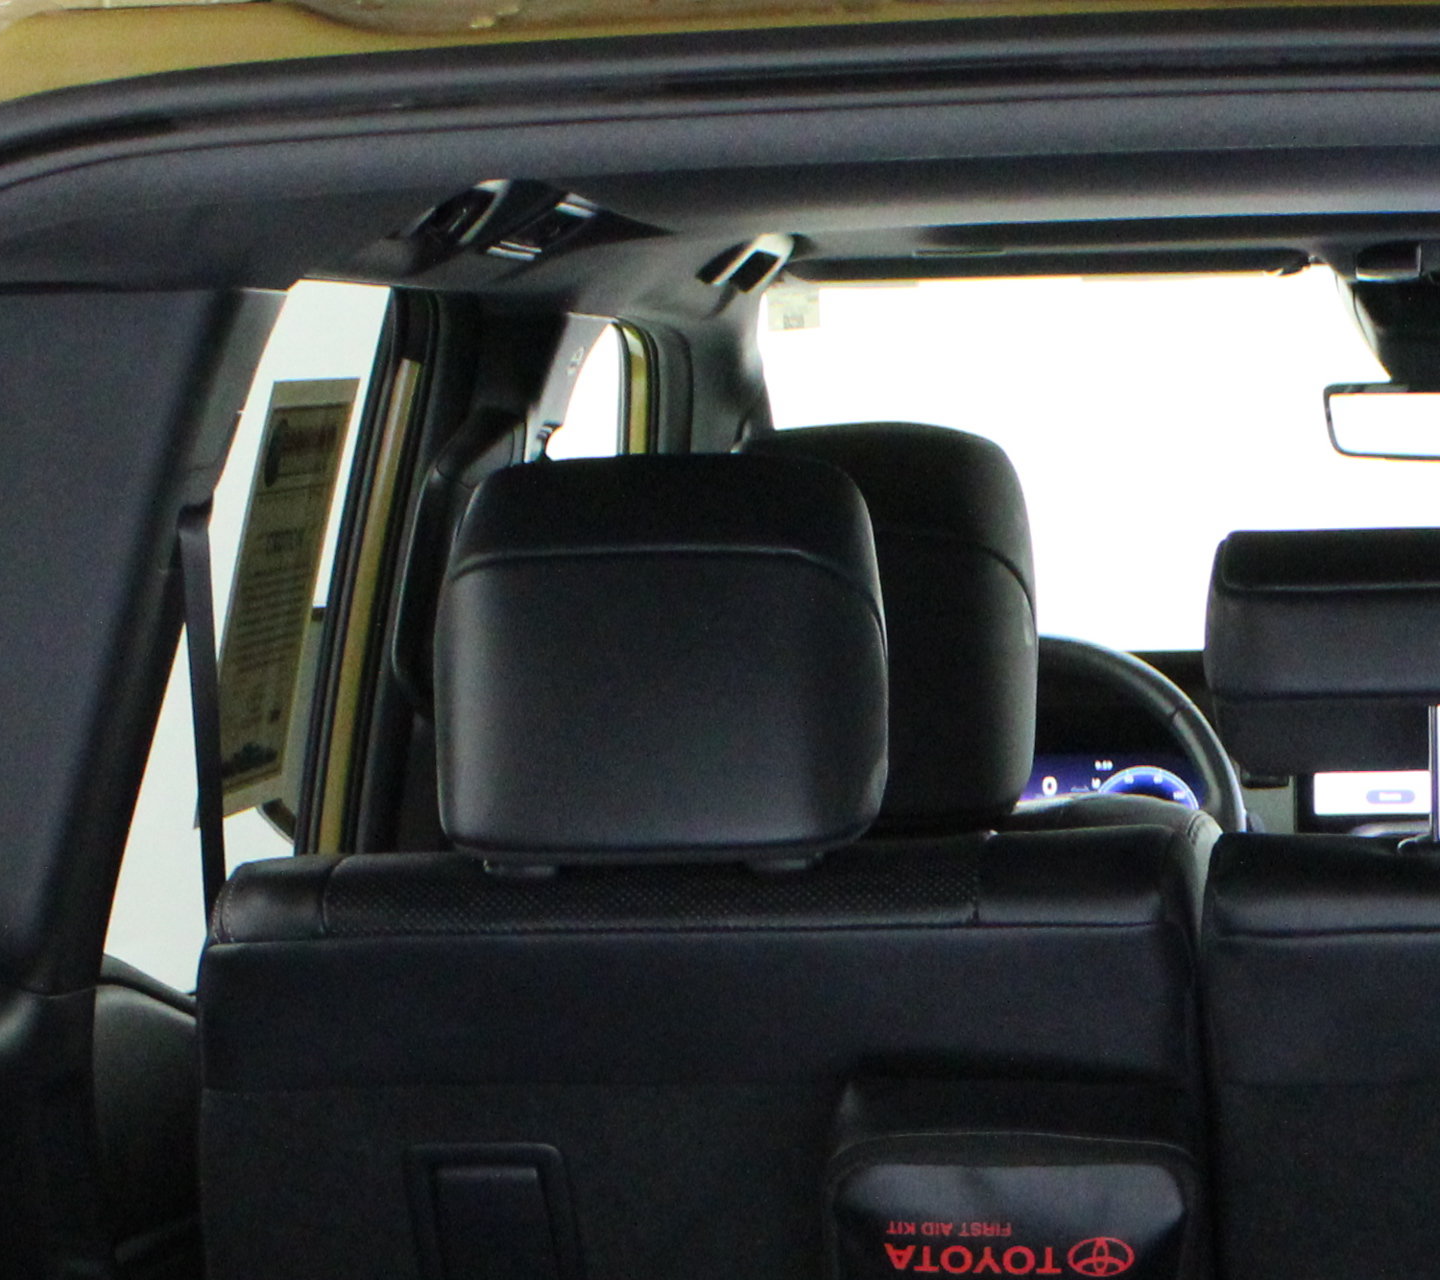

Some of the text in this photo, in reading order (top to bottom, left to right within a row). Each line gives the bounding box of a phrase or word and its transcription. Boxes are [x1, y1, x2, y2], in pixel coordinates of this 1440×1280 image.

[886, 1220, 1012, 1237] FIRST AID KIT
[884, 1243, 1062, 1274] TOYOTA
